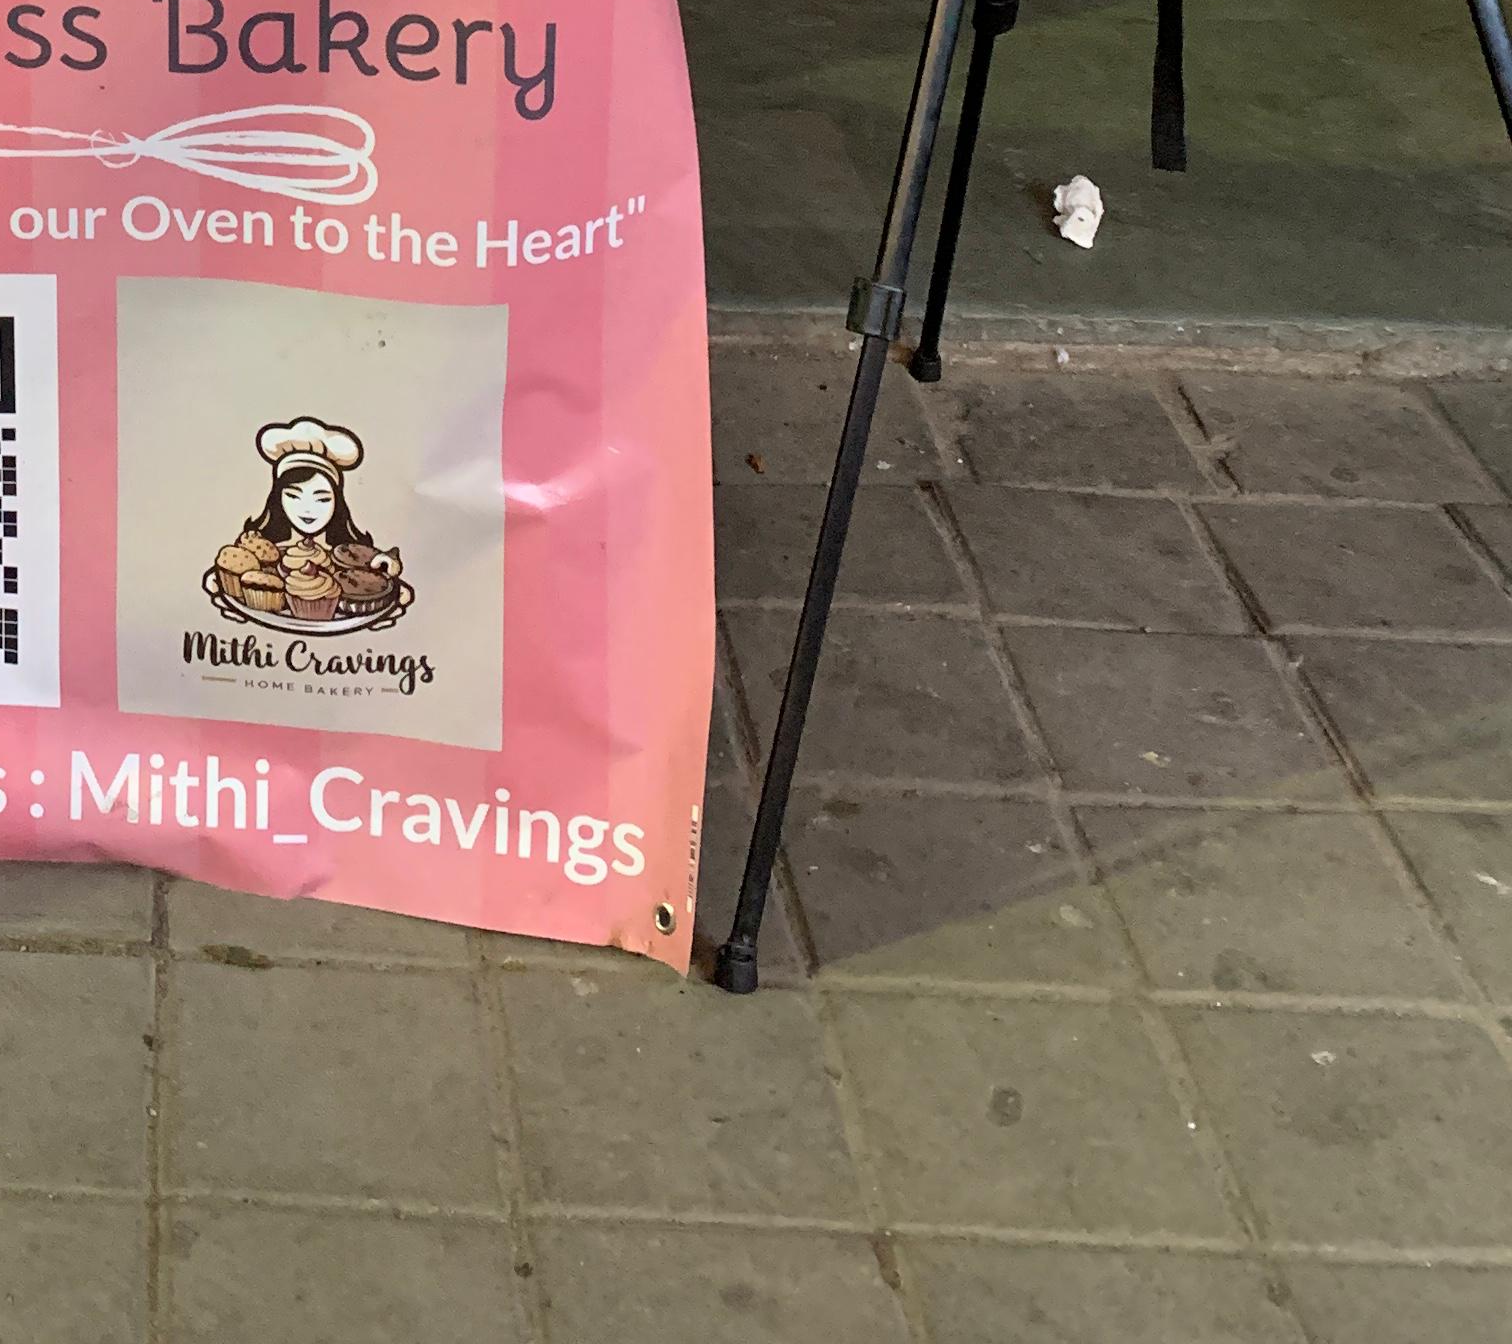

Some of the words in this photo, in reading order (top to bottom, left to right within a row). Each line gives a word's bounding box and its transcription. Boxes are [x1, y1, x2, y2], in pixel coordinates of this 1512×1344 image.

[9, 206, 108, 240] our
[121, 194, 275, 247] Oven
[290, 205, 350, 254] to
[363, 212, 460, 267] the
[475, 194, 647, 269] Heart"
[183, 631, 279, 670] Mithi
[285, 640, 438, 696] Cravings
[244, 679, 295, 691] HOME
[304, 683, 376, 698] BAKERY
[69, 749, 647, 886] Mithi_Cravings
